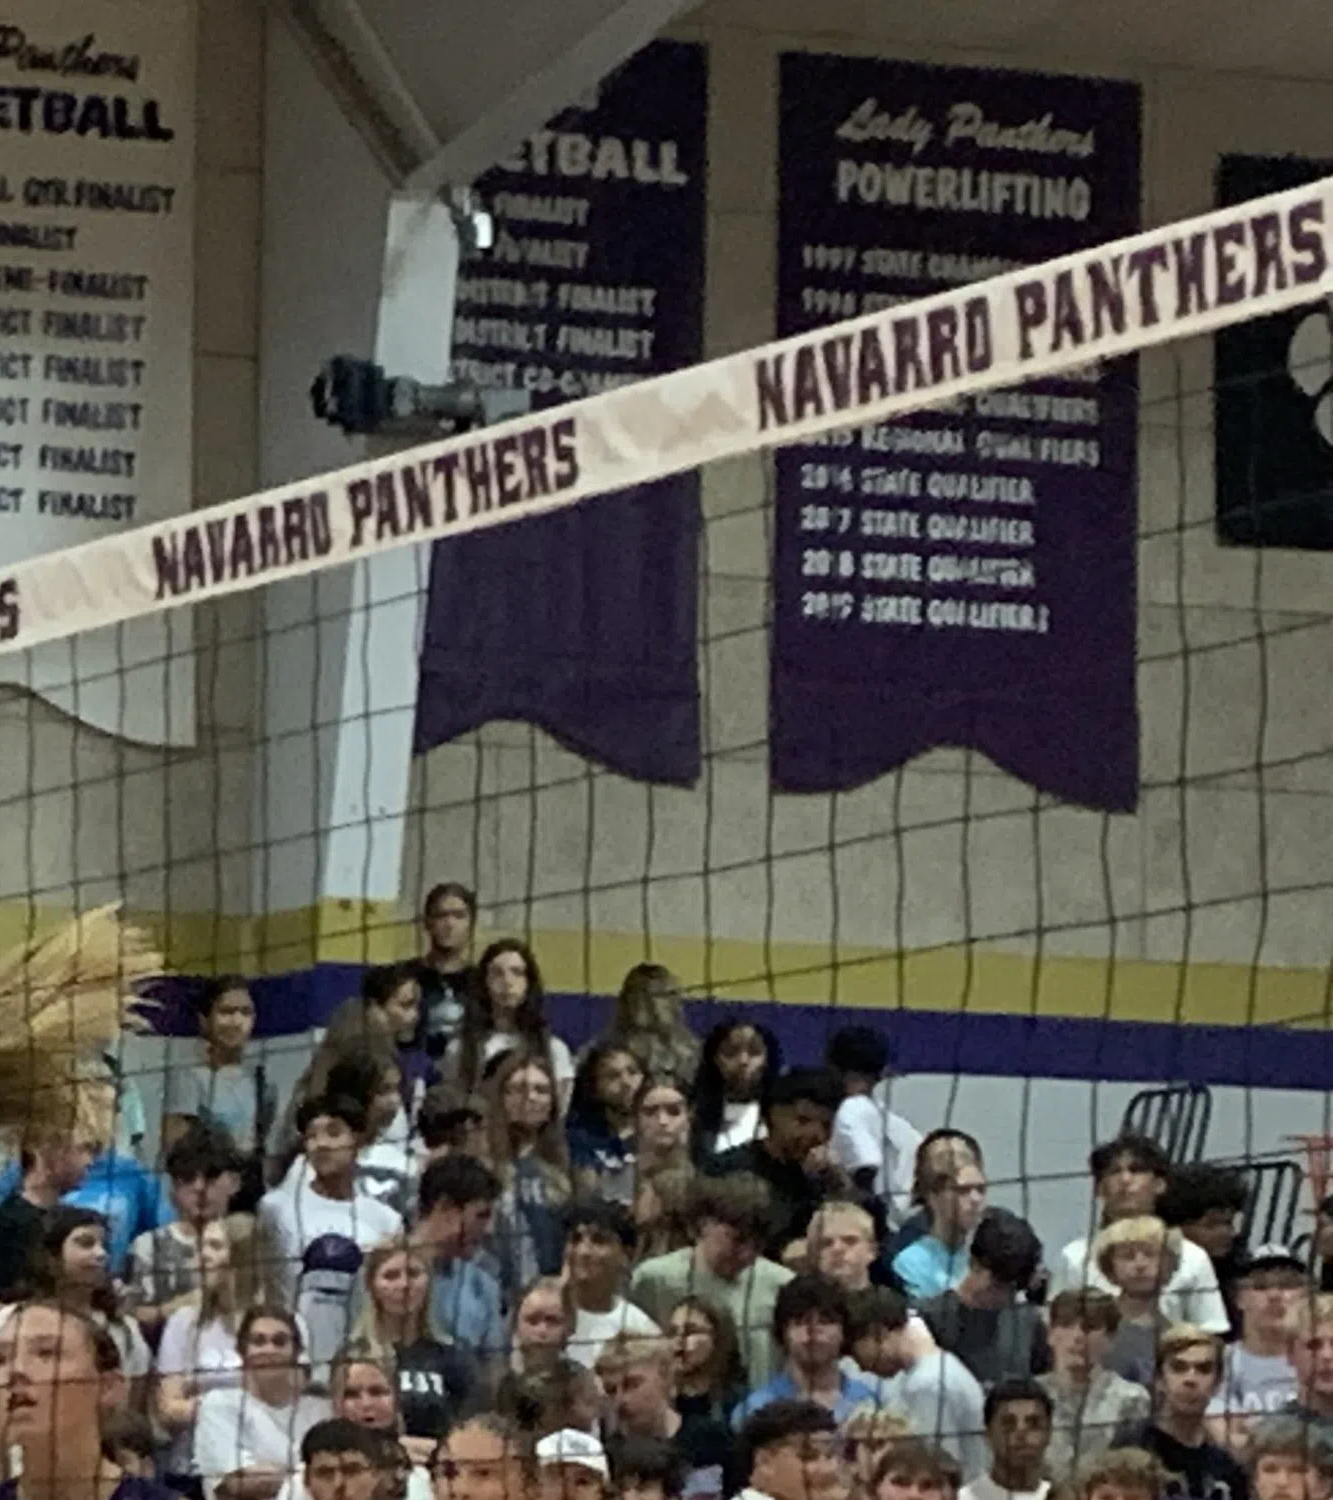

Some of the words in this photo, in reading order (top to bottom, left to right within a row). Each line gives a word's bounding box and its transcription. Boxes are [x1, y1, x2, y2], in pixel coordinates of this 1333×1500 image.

[836, 97, 933, 156] Lady
[945, 102, 1095, 158] Panthers
[837, 159, 1092, 222] POWERLIFTING
[42, 310, 147, 342] FINALIST
[755, 296, 992, 433] NAVARRO
[1014, 198, 1328, 362] PANTHERS
[43, 353, 146, 388] FINALIST
[42, 397, 143, 431] FINALIST
[39, 444, 136, 479] FINALIST
[860, 467, 922, 499] STATE
[38, 490, 137, 522] FINALIST
[152, 491, 332, 598] NAVARRO
[348, 417, 580, 548] PANTHERS
[801, 504, 852, 533] 207
[860, 508, 922, 539] STATE
[802, 548, 855, 577] 208
[860, 552, 923, 582] STATE
[860, 595, 923, 625] STATE
